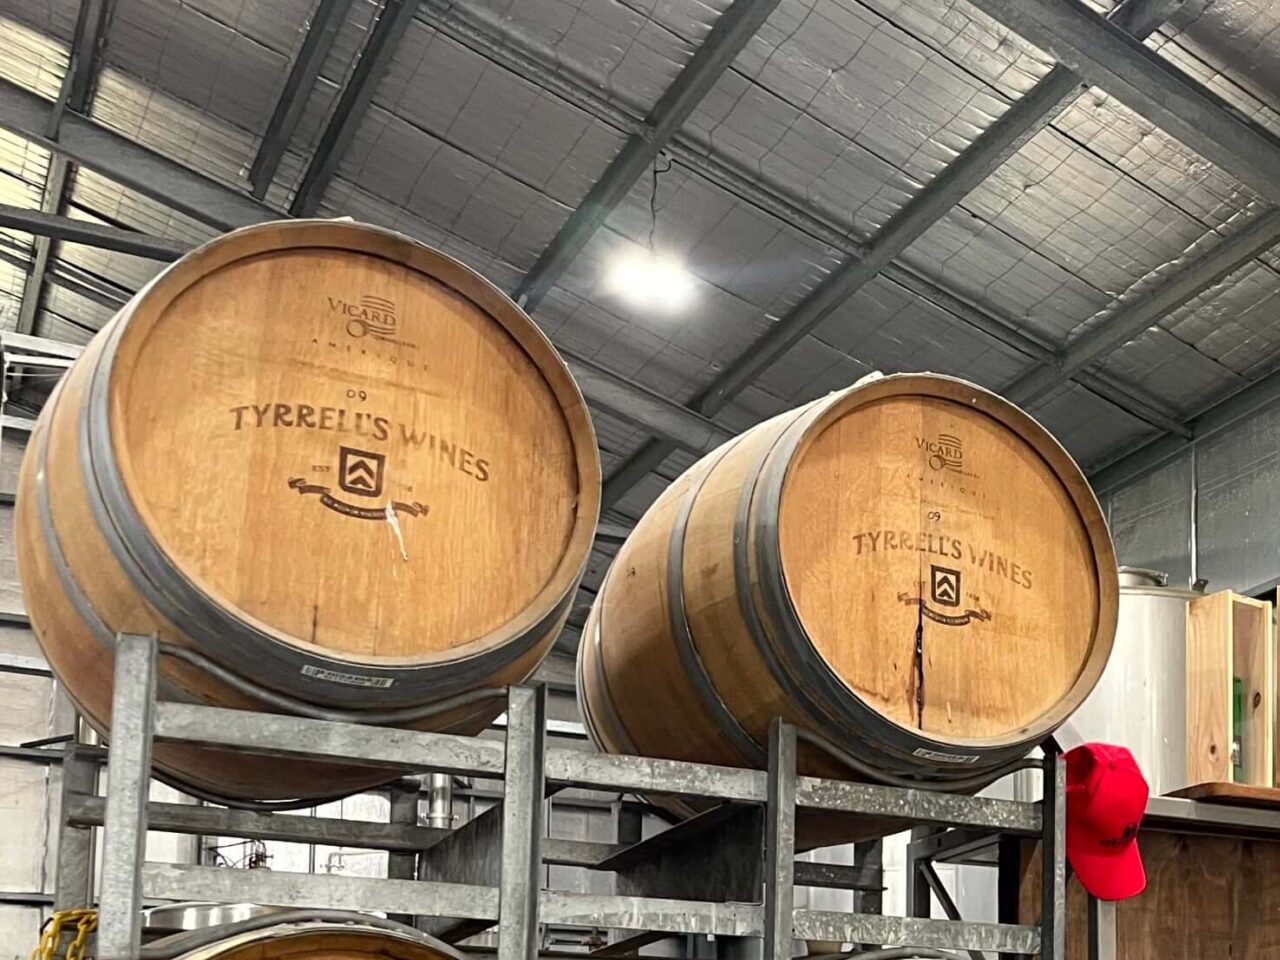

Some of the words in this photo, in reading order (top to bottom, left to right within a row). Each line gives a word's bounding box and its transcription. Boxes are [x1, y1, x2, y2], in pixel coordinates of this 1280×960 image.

[328, 297, 396, 327] VICARD
[346, 389, 367, 402] 09
[229, 403, 389, 441] TYRRELL'S
[399, 423, 490, 482] WINES
[916, 437, 963, 460] VICARD
[927, 511, 941, 523] 09
[853, 530, 963, 560] TYRRELL'S
[968, 543, 1033, 590] WINES
